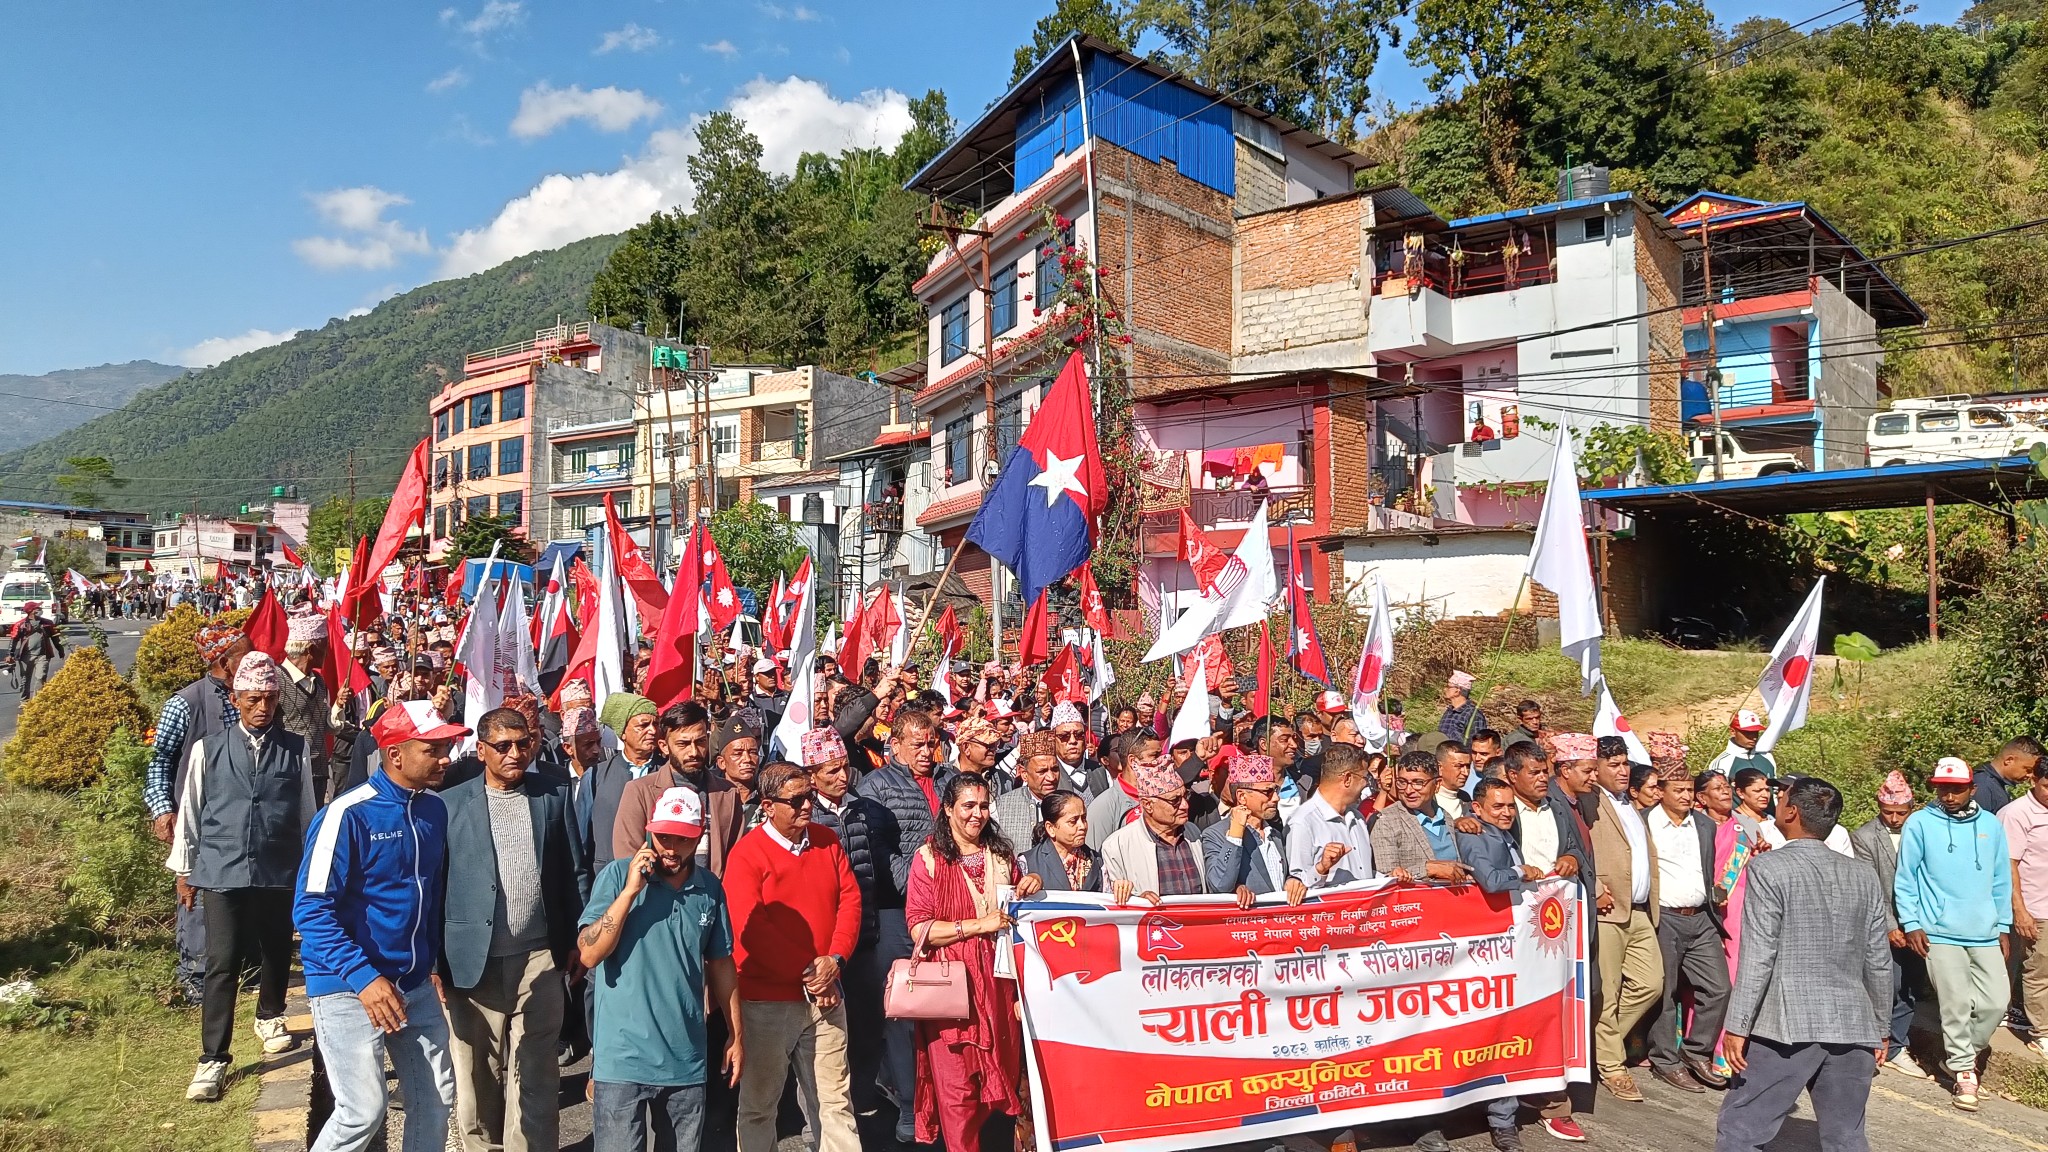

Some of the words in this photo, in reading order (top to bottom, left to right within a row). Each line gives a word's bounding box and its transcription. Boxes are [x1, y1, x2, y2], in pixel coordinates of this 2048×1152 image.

[370, 830, 403, 841] KELME
[1263, 927, 1293, 939] नेपाल
[1298, 925, 1321, 940] सुखी
[1326, 923, 1355, 936] नेपाली
[1142, 951, 1261, 992] लोकतन्त्रको
[1274, 945, 1328, 984] जगेर्ना
[1337, 952, 1354, 981] र
[1360, 934, 1458, 975] संविधानको
[1467, 927, 1517, 965] रक्षार्थ
[1285, 985, 1344, 1031] एवं
[1357, 973, 1517, 1022] जनसभा
[1272, 1042, 1309, 1056] २०८२
[1314, 1035, 1349, 1052] कार्तिक
[1146, 1078, 1234, 1108] नेपाल
[1242, 1060, 1374, 1094] कम्युनिष्ट
[1383, 1047, 1443, 1075] पार्टी
[1453, 1035, 1533, 1069] (एमाले)
[1264, 1092, 1315, 1110] जिल्ला
[1374, 1079, 1410, 1093] पर्वत
